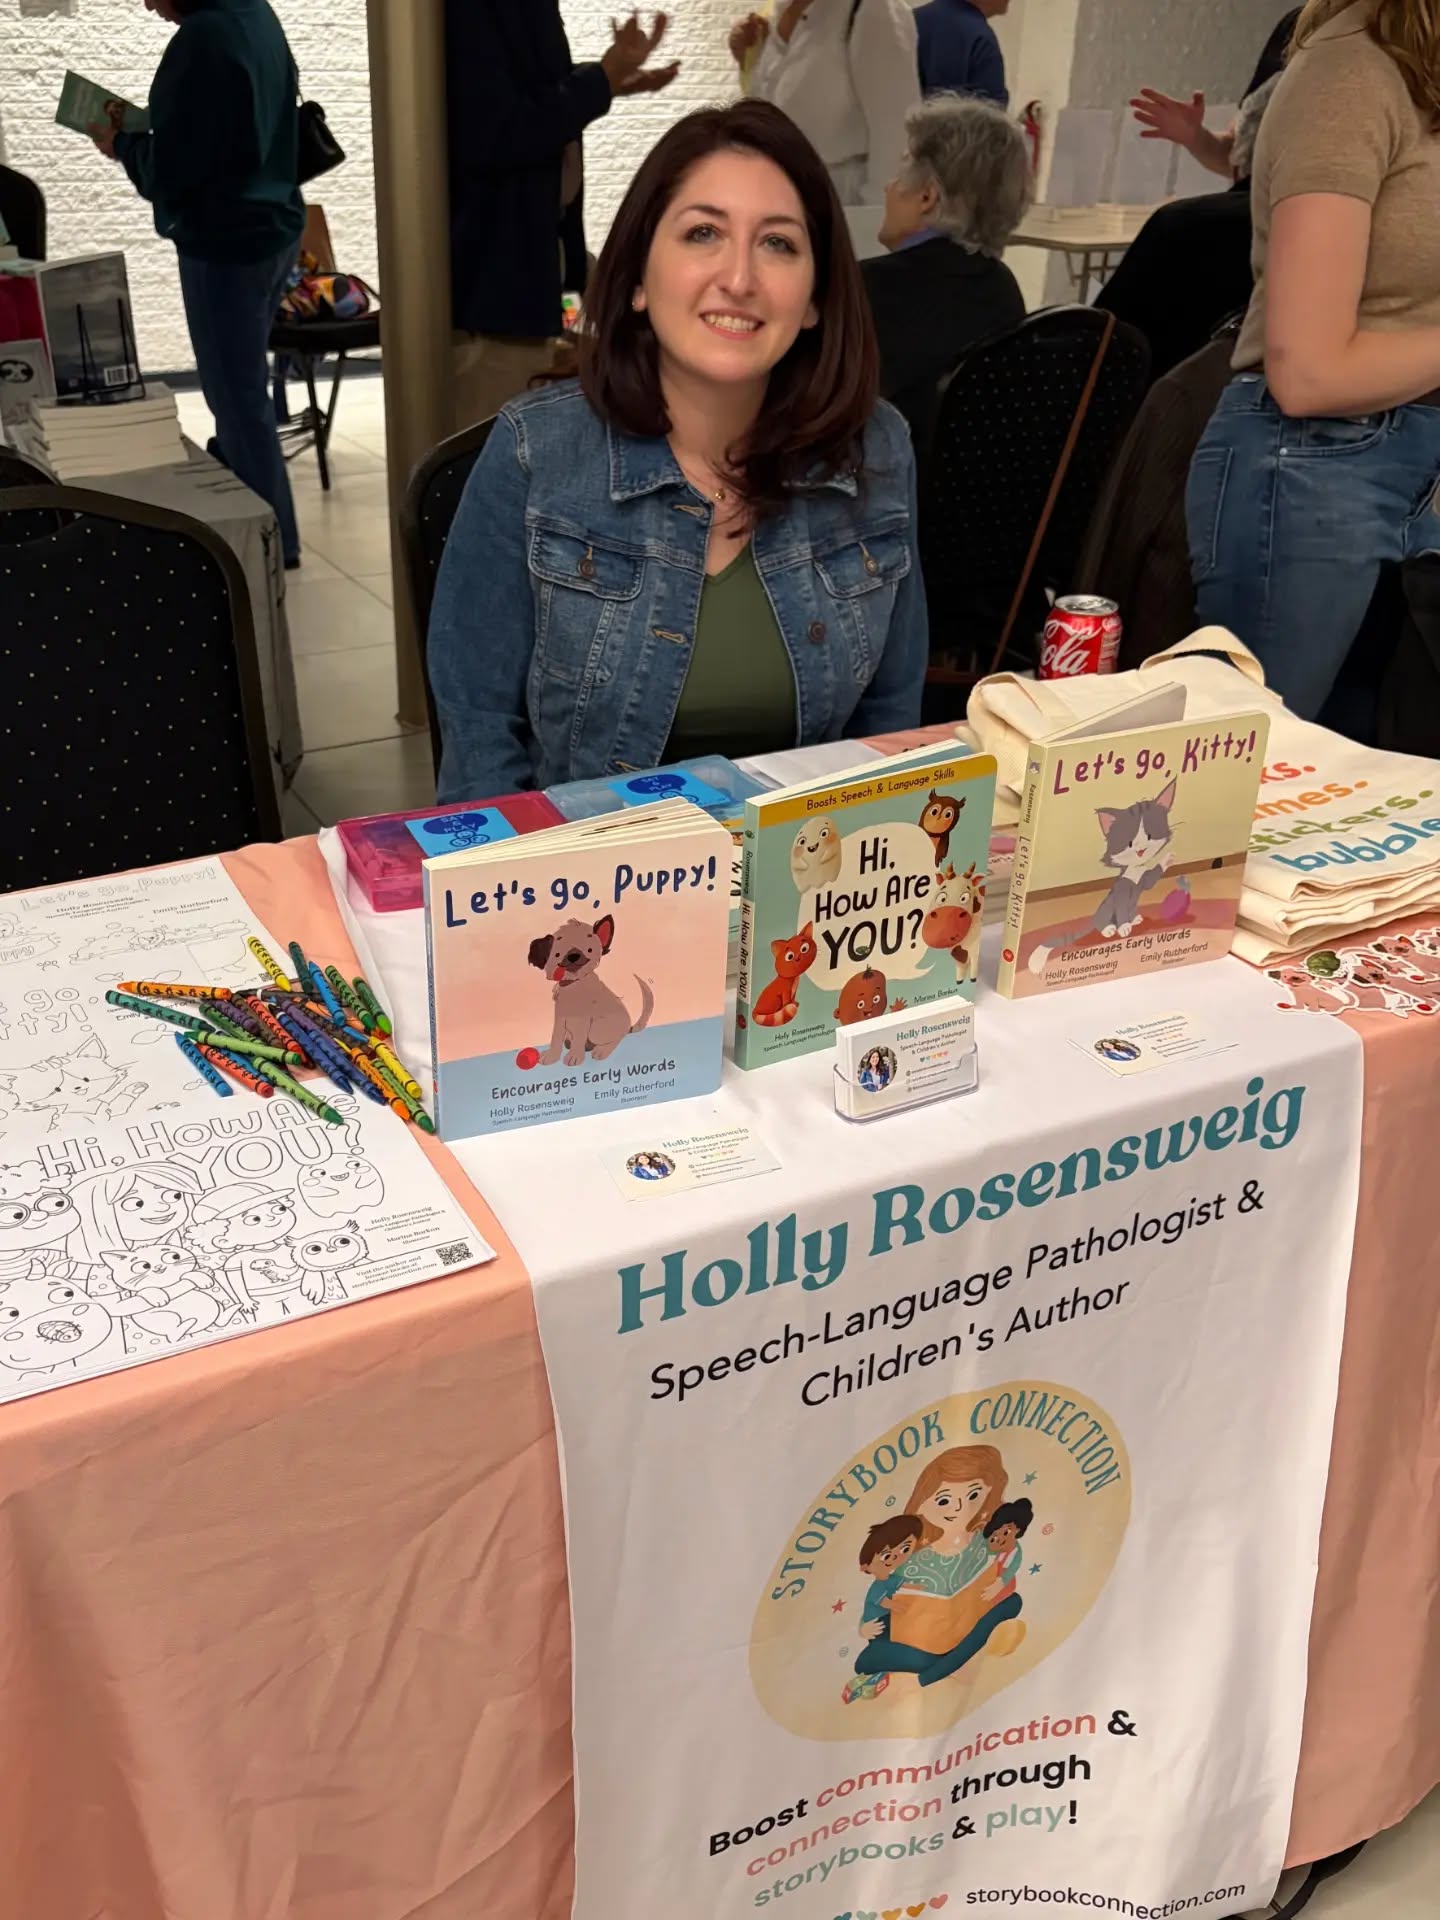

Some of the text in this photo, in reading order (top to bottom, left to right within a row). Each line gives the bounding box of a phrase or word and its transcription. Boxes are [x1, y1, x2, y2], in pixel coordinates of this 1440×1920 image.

[1053, 730, 1256, 795] Let's go, Kitty!
[807, 768, 955, 811] Boosts Speech & Language Skills
[859, 837, 896, 875] Hi,
[445, 881, 536, 928] Let's
[551, 877, 600, 909] go,
[614, 856, 716, 902] Puppy!
[815, 874, 931, 923] How Are
[741, 921, 750, 945] How
[821, 909, 924, 970] YOU?
[1061, 928, 1191, 962] Encourages Early Words
[1140, 942, 1208, 963] Emily Rutherford
[740, 947, 749, 966] Are
[1045, 960, 1119, 981] Holly Rosensweig
[739, 971, 749, 999] YOU?
[896, 1015, 971, 1043] Holly Rosensweig
[491, 1058, 676, 1100] Encourages Early Words
[594, 1078, 675, 1100] Emily Rutherford
[490, 1096, 575, 1118] Holly Rosensweig
[37, 1137, 125, 1178] Hi,
[126, 1111, 262, 1158] How
[166, 1118, 364, 1191] YOU?
[616, 1076, 1306, 1334] Holly Rosensweig
[650, 1180, 1265, 1401] Speech-Language Pathologist &
[801, 1279, 1130, 1407] Children's Author
[771, 1390, 1122, 1600] STORYBOOK CONNECTION
[708, 1710, 1137, 1856] Boost communication &
[746, 1755, 1091, 1877] connection through
[753, 1800, 1078, 1907] storybooks & play!
[966, 1882, 1246, 1919] storybookconnection.com
